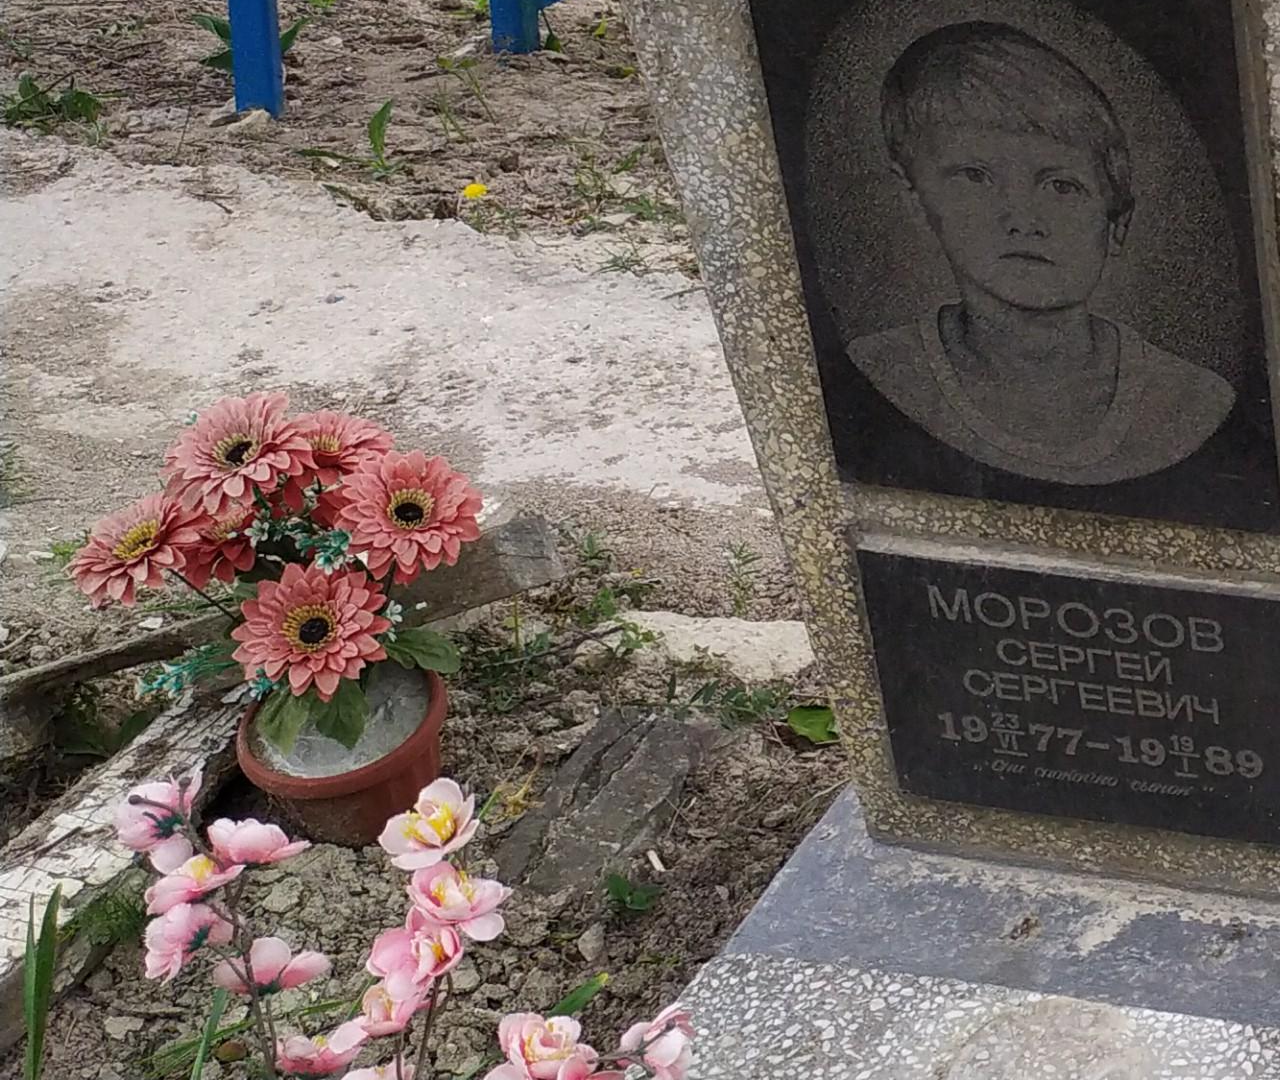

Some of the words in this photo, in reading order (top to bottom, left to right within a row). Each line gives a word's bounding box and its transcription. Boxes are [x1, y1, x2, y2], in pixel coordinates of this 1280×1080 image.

[926, 584, 1225, 654] МОРОЗОВ
[996, 637, 1174, 685] СЕРГЕЙ
[962, 669, 1220, 724] СЕРГЕЕВИЧ
